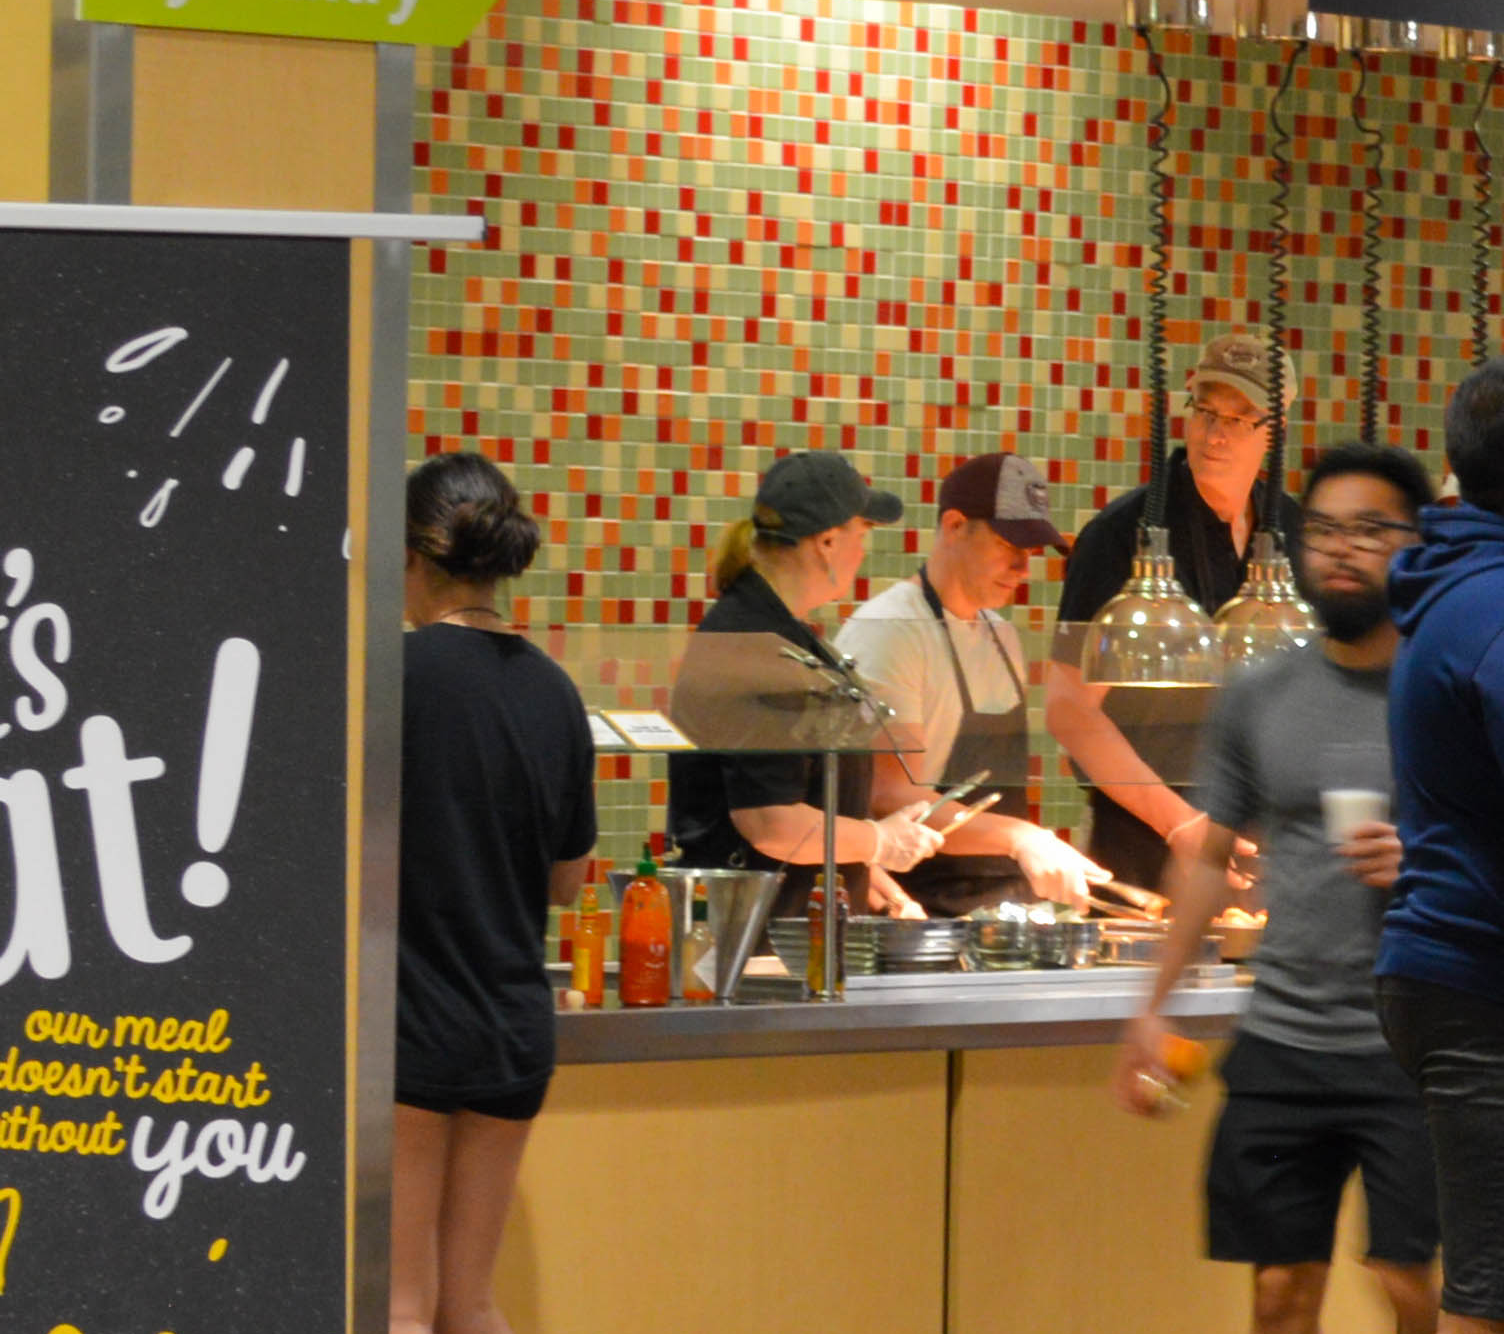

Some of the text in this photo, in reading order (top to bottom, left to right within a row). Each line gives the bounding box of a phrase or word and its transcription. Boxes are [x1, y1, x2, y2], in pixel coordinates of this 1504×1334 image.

[24, 1007, 233, 1054] our meal
[150, 1056, 272, 1109] start
[130, 1114, 308, 1220] you
